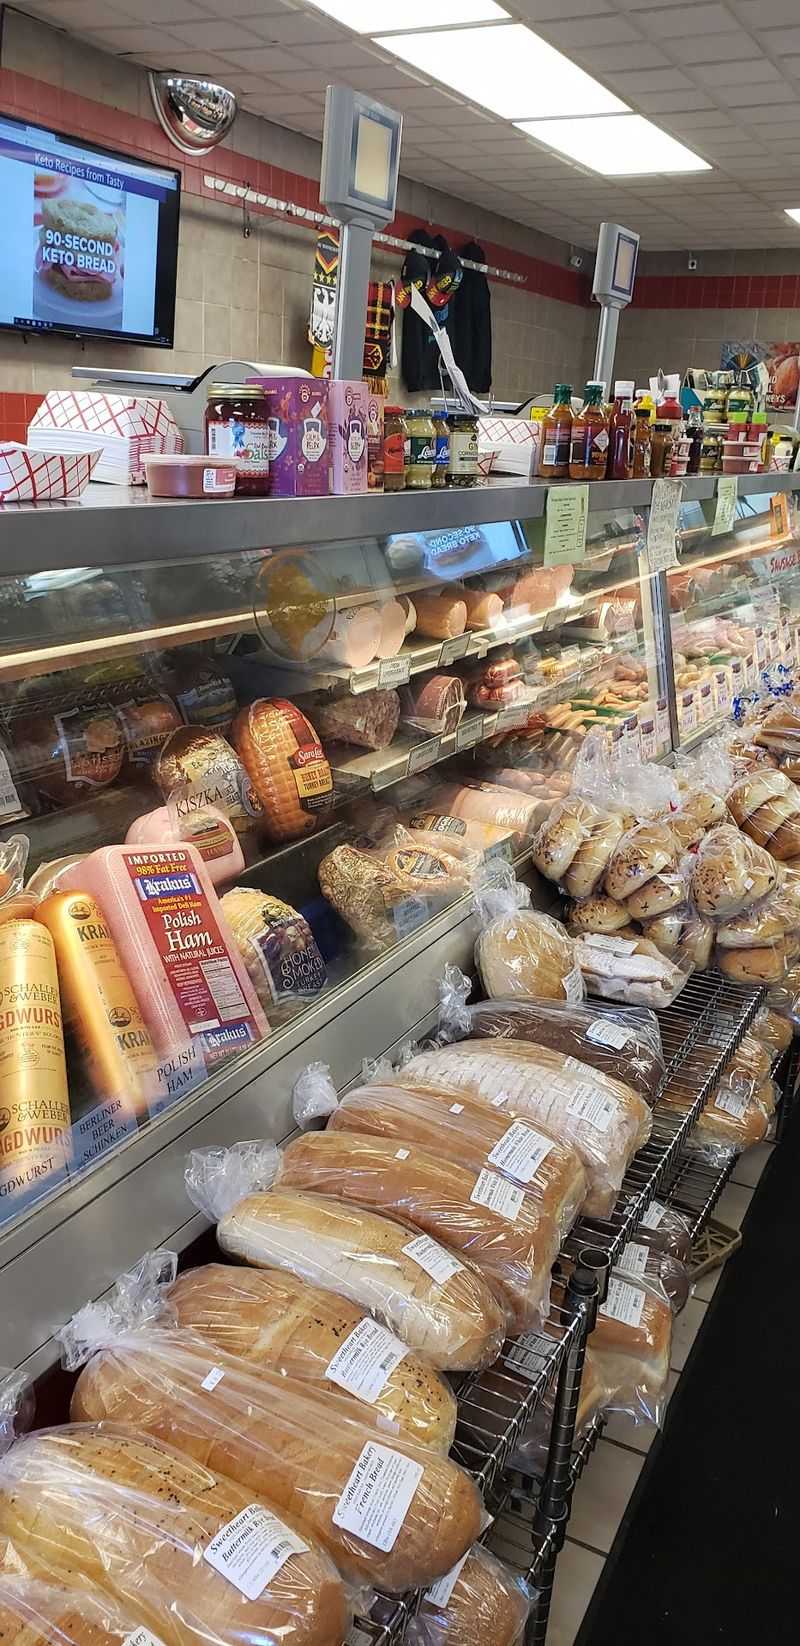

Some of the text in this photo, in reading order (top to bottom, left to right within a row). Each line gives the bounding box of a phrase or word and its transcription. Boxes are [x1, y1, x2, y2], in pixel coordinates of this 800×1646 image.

[34, 152, 125, 191] Keto Recipes from Tasty
[45, 229, 113, 257] 90-SECOND
[42, 246, 116, 274] KETO BREAD
[298, 746, 325, 765] Sara Lee
[175, 786, 223, 818] KISZKA
[127, 852, 187, 865] IMPORTED
[136, 863, 188, 877] 98% Fat Free
[143, 875, 192, 896] Krakus
[152, 900, 202, 914] Imported Deli Ham
[162, 910, 202, 929] Polish
[166, 928, 213, 953] Ham
[163, 945, 225, 964] WITH NATURAL JUICES
[207, 1024, 248, 1048] Krakus
[156, 1045, 197, 1083] POLISH
[165, 1067, 194, 1096] HAM
[79, 1099, 122, 1135] BERLINER
[90, 1118, 116, 1141] BEER
[82, 1124, 129, 1161] SCHINKEN
[358, 1446, 377, 1472] Bakery
[355, 1456, 386, 1515] French Bread
[210, 1513, 250, 1554] Sweetheart
[221, 1526, 255, 1562] Buttermilk
